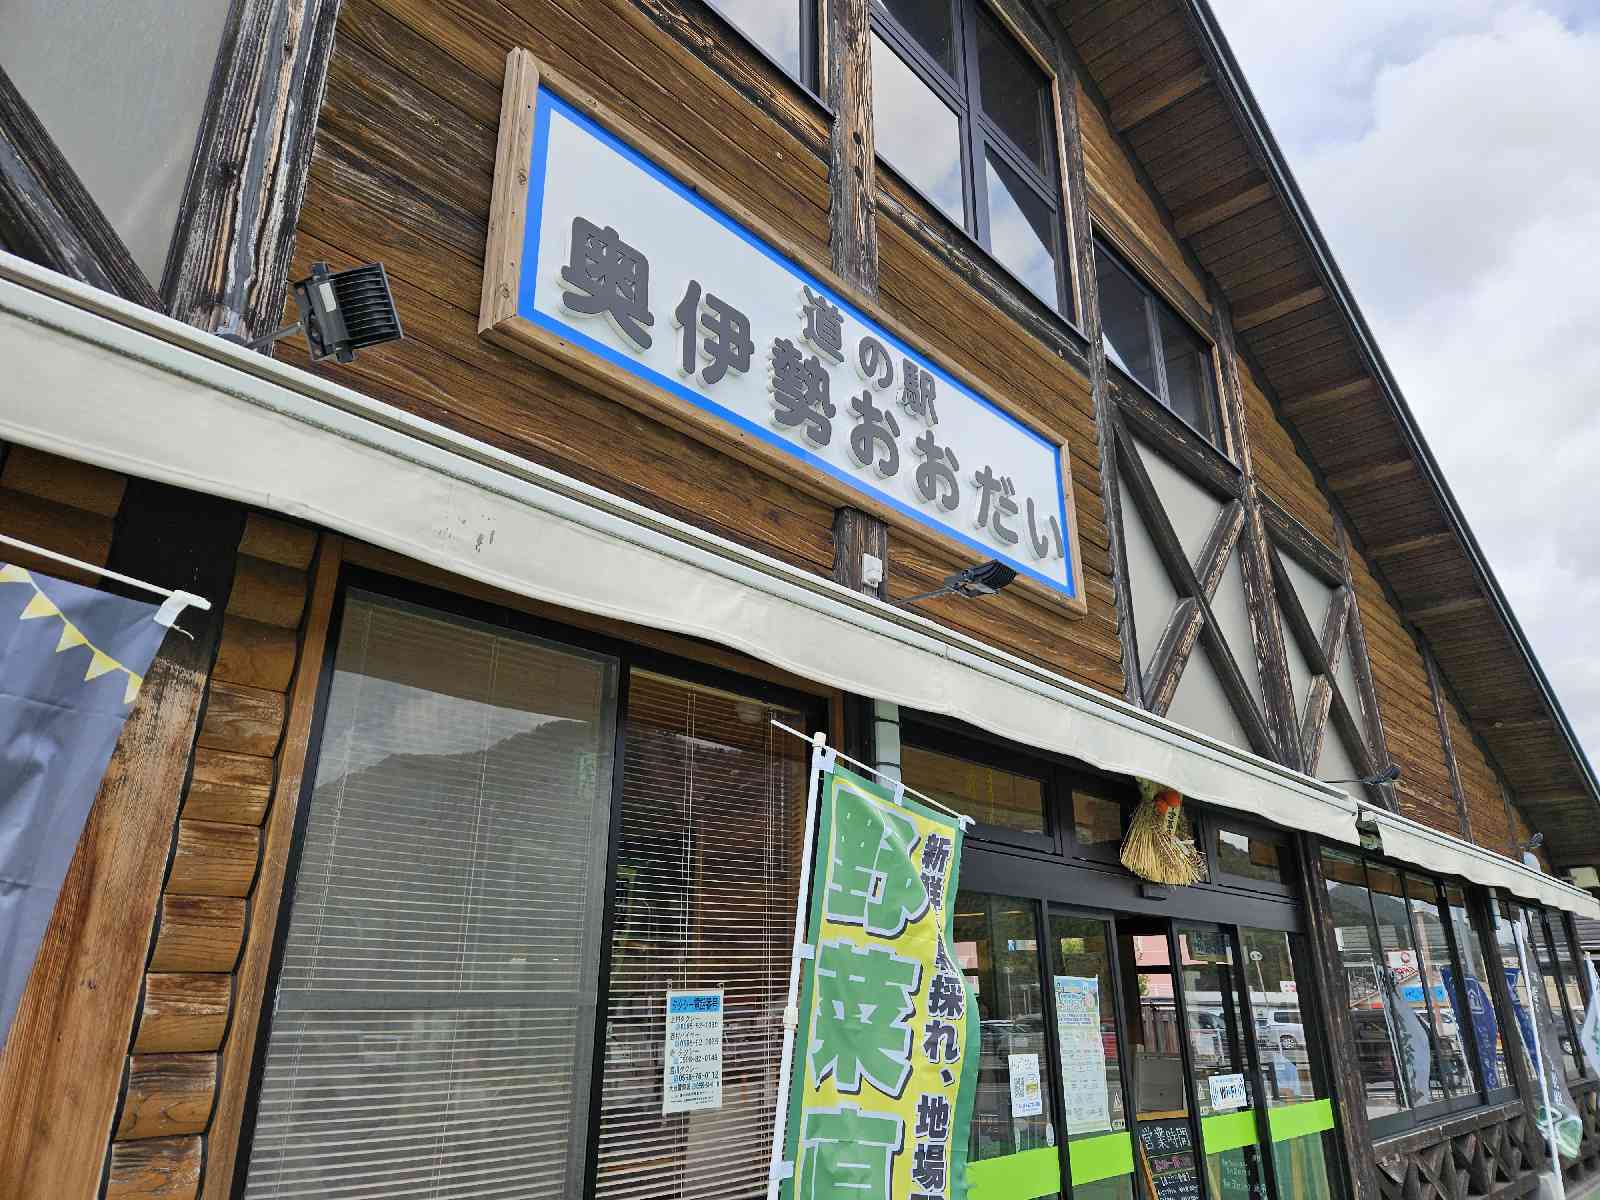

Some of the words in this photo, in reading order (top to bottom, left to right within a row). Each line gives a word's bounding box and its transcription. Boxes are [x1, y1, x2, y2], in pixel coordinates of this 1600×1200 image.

[559, 215, 1065, 562] 奥伊勢おおだい
[801, 285, 940, 426] 道の駅
